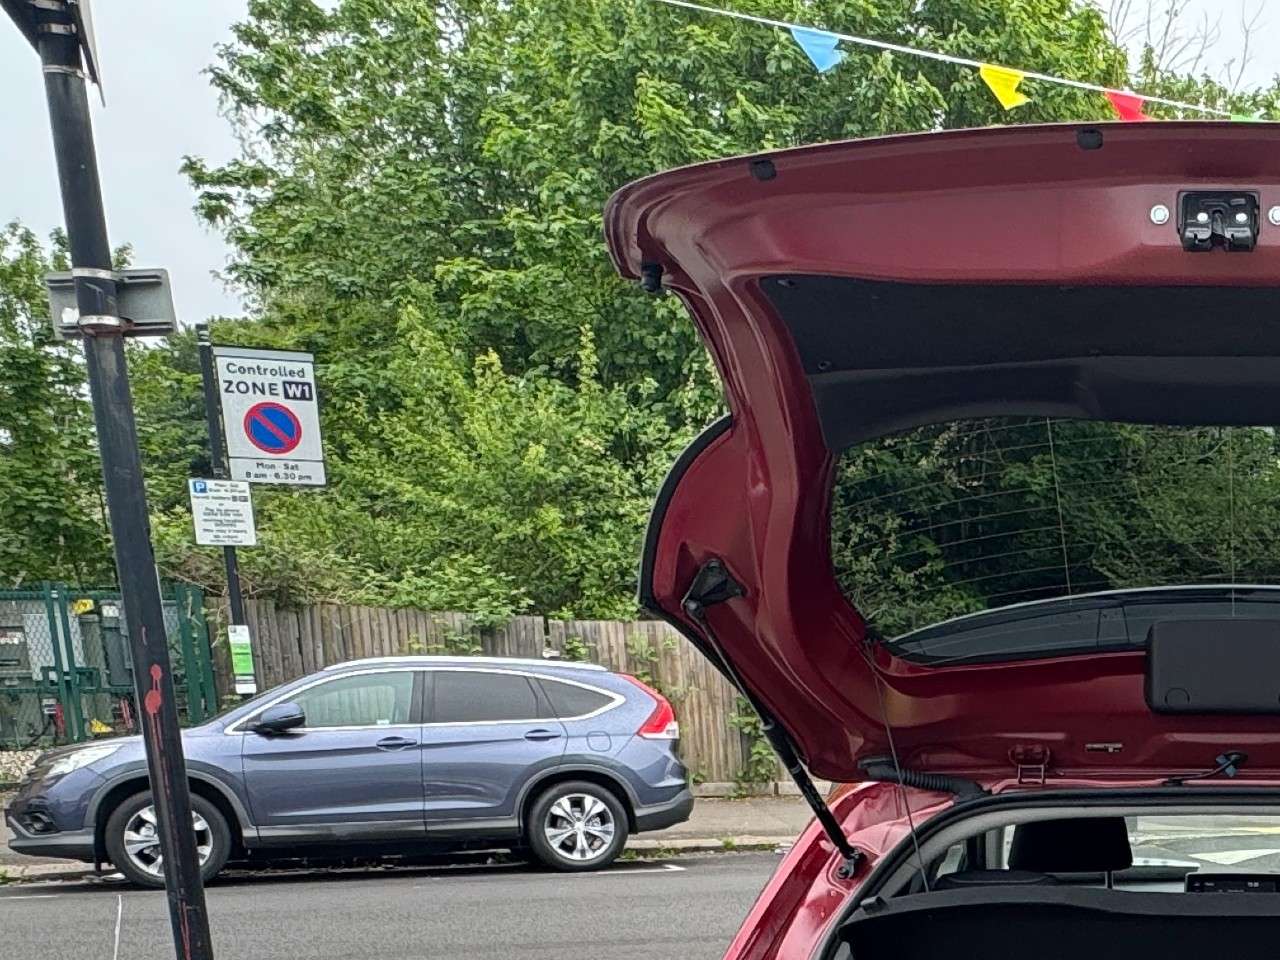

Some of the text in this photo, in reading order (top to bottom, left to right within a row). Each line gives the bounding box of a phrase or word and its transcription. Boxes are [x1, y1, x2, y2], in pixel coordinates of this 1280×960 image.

[226, 362, 305, 378] Controlled
[223, 380, 311, 398] ZONE W1
[256, 462, 276, 470] Mon
[283, 463, 299, 471] Sat
